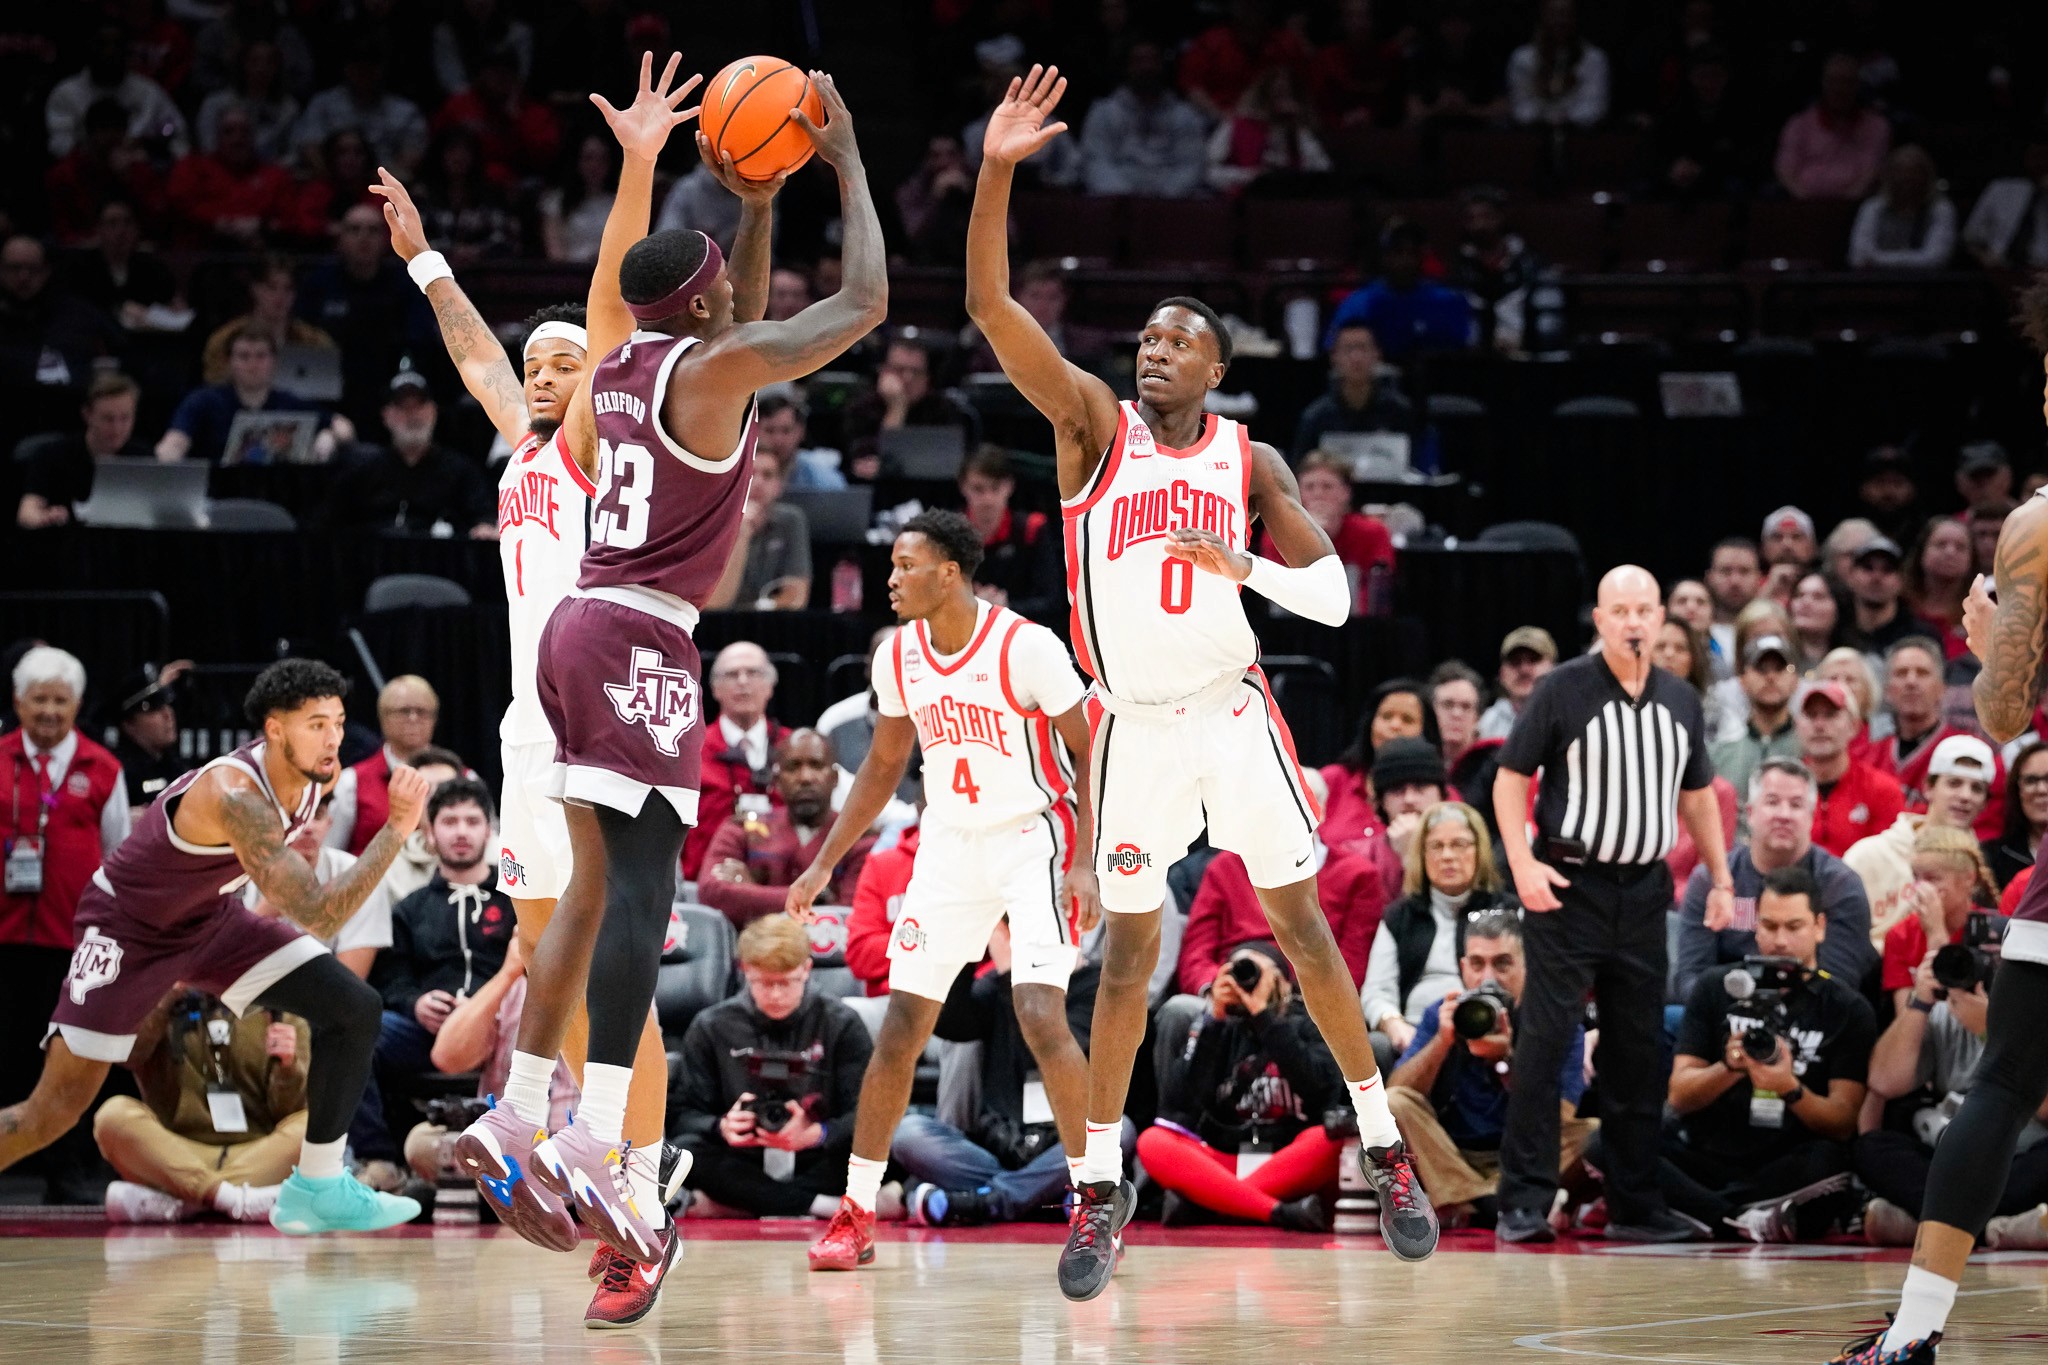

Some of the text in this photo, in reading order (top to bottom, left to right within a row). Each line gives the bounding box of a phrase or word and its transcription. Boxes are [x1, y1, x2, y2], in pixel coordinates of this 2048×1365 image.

[592, 437, 654, 549] 23
[516, 539, 524, 596] 1
[1160, 556, 1193, 615] 0
[952, 757, 981, 804] 4
